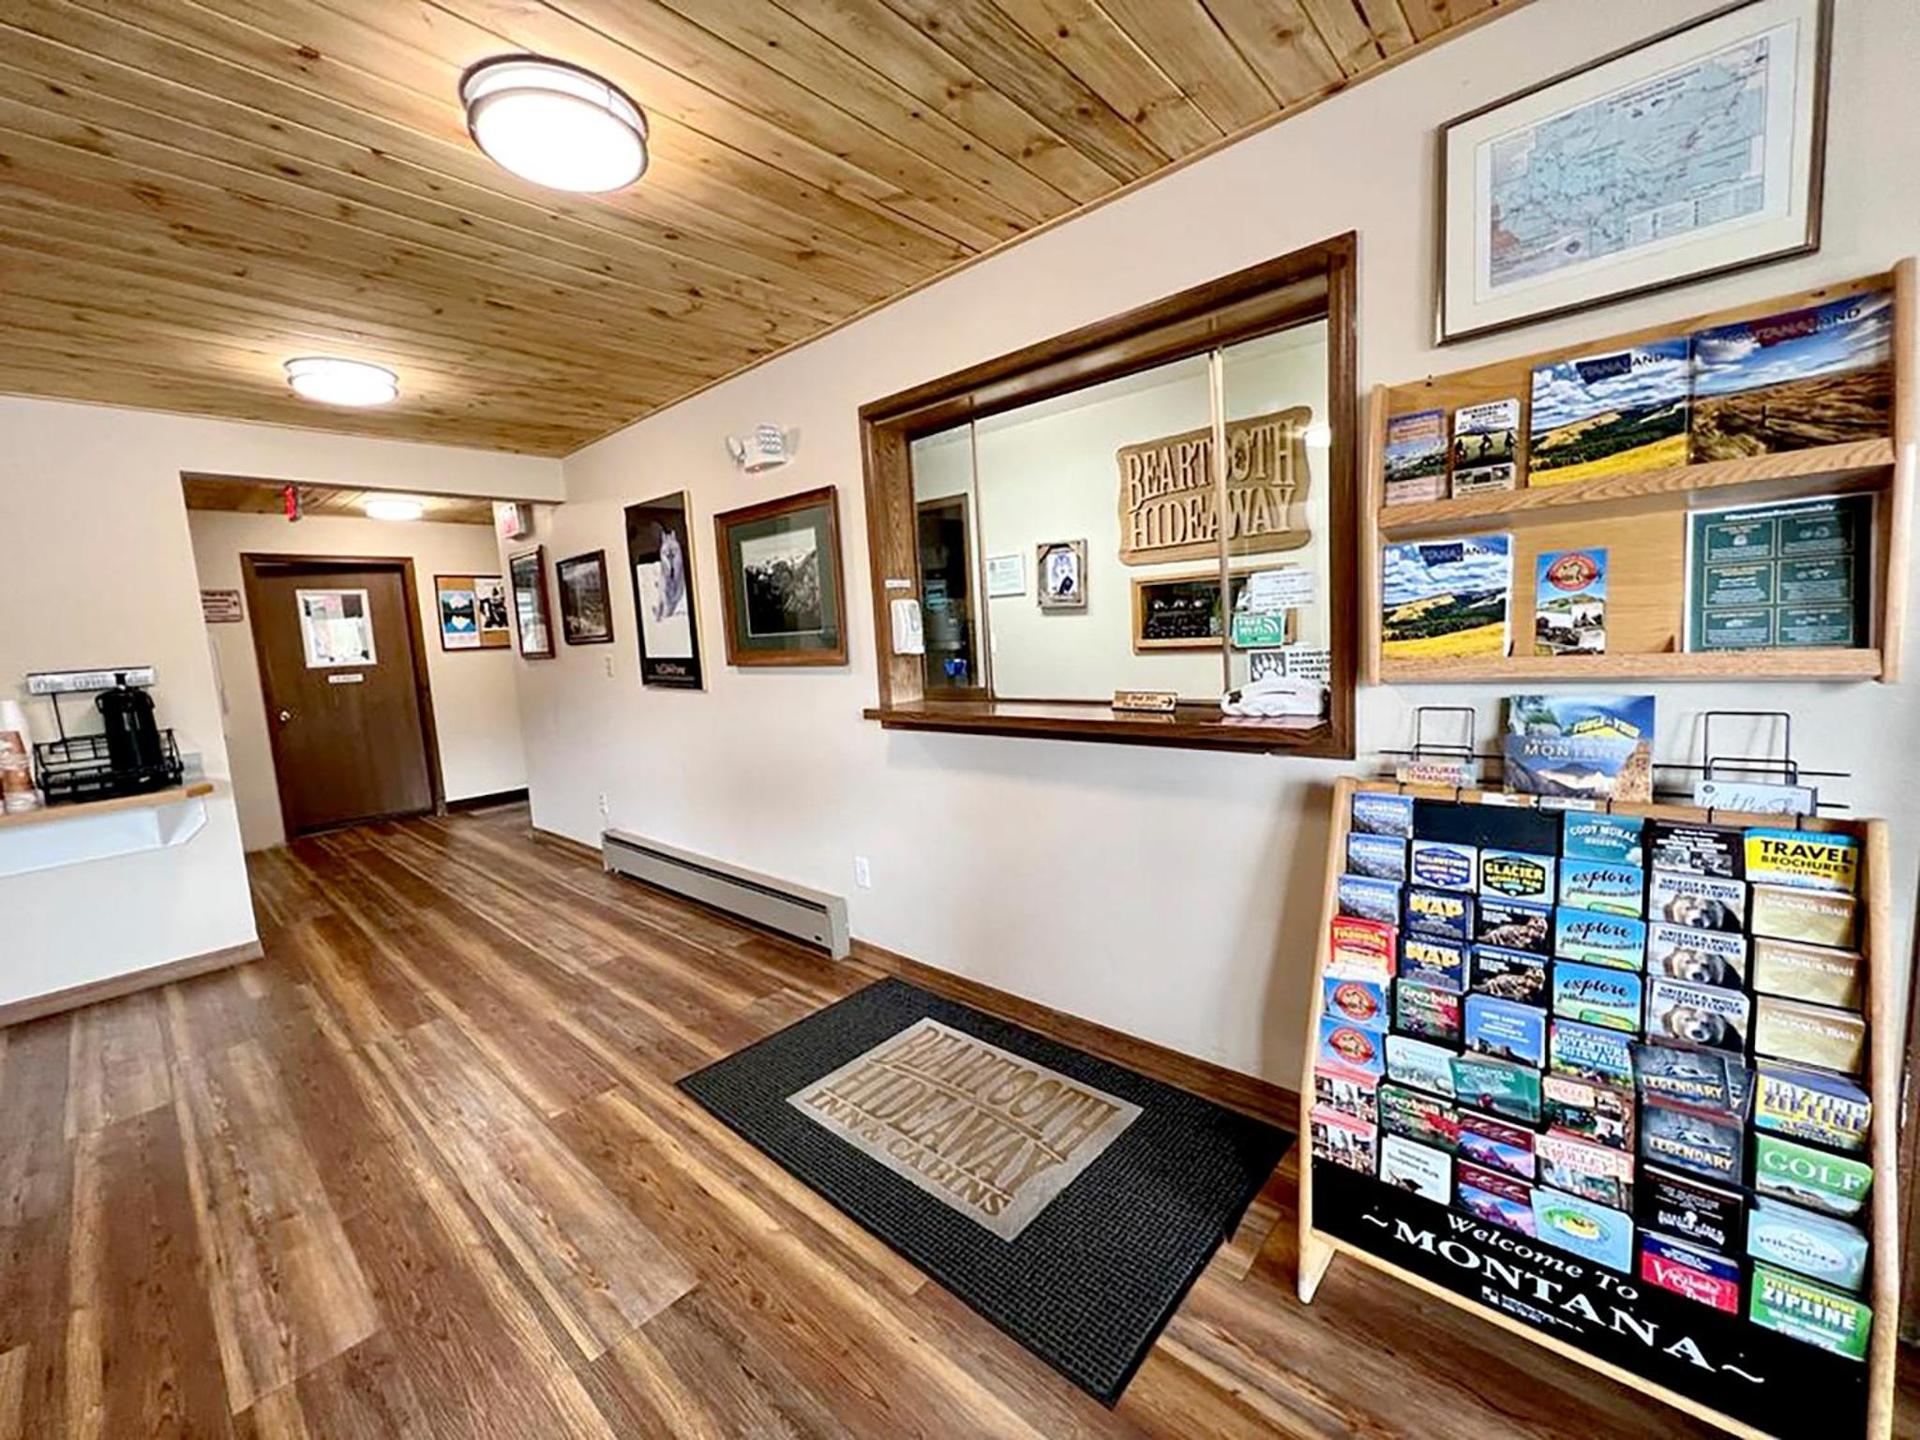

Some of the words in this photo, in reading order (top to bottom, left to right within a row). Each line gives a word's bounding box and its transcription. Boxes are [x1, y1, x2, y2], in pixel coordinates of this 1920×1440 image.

[1129, 486, 1296, 552] HIDEAWAY
[1761, 839, 1854, 865] TRAVEL
[1761, 854, 1850, 874] BROCHURES
[1484, 862, 1544, 880] GLACIER
[1572, 870, 1634, 888] explore
[1710, 884, 1738, 892] WOLF
[1408, 894, 1465, 918] MAP
[1566, 922, 1631, 939] explore
[1711, 938, 1739, 947] WOLF
[1405, 939, 1461, 967] MAP
[1563, 979, 1628, 996] explore
[1711, 996, 1740, 1007] WOLF
[867, 1026, 1123, 1155] BEARTOOTH
[1642, 1074, 1724, 1100] LEGENDARY
[823, 1063, 1054, 1196] HIDEAWAY
[802, 1088, 868, 1129] INN
[861, 1124, 881, 1141] &
[887, 1138, 1012, 1218] CABINS
[1649, 1136, 1734, 1171] LEGENDARY
[1763, 1150, 1866, 1191] GOLF
[1446, 1212, 1584, 1278] Welcome
[1595, 1270, 1641, 1301] To
[1760, 1285, 1858, 1332] ZIPLINE
